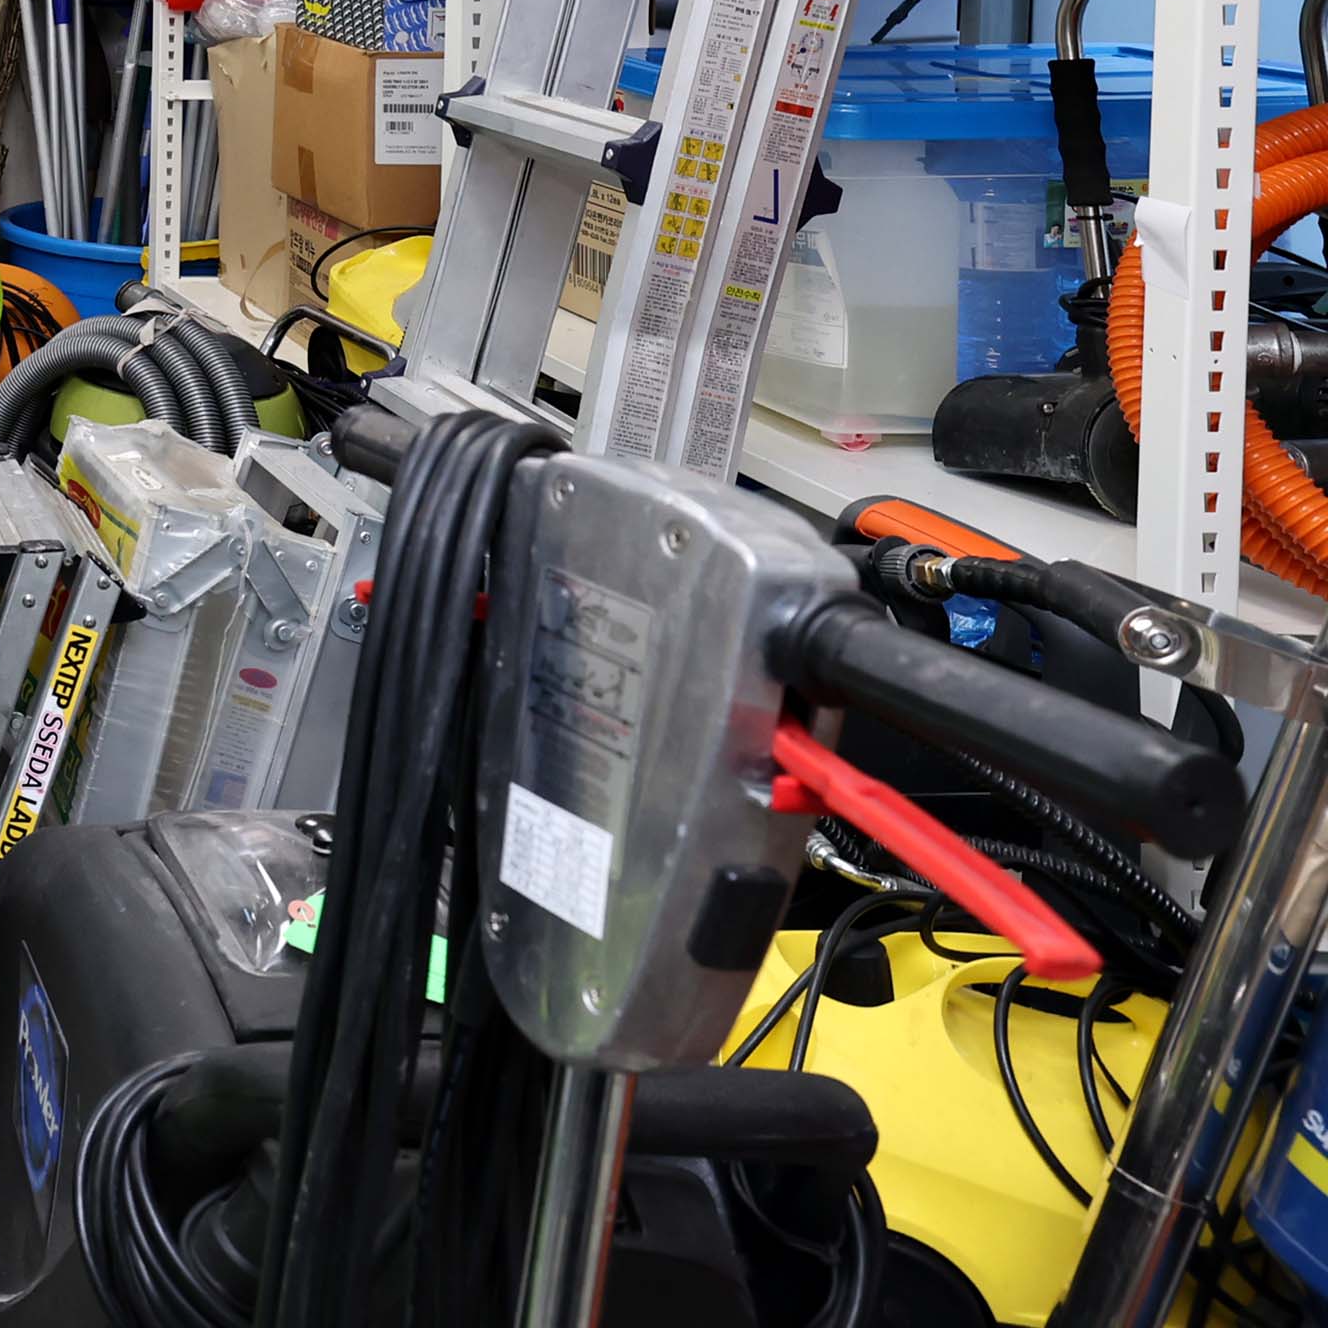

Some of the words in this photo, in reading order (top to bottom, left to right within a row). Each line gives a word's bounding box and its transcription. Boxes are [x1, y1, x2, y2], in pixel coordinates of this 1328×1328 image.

[725, 285, 762, 301] 안전수칙
[52, 631, 92, 710] NEXTEP
[22, 712, 63, 788] SSEDA
